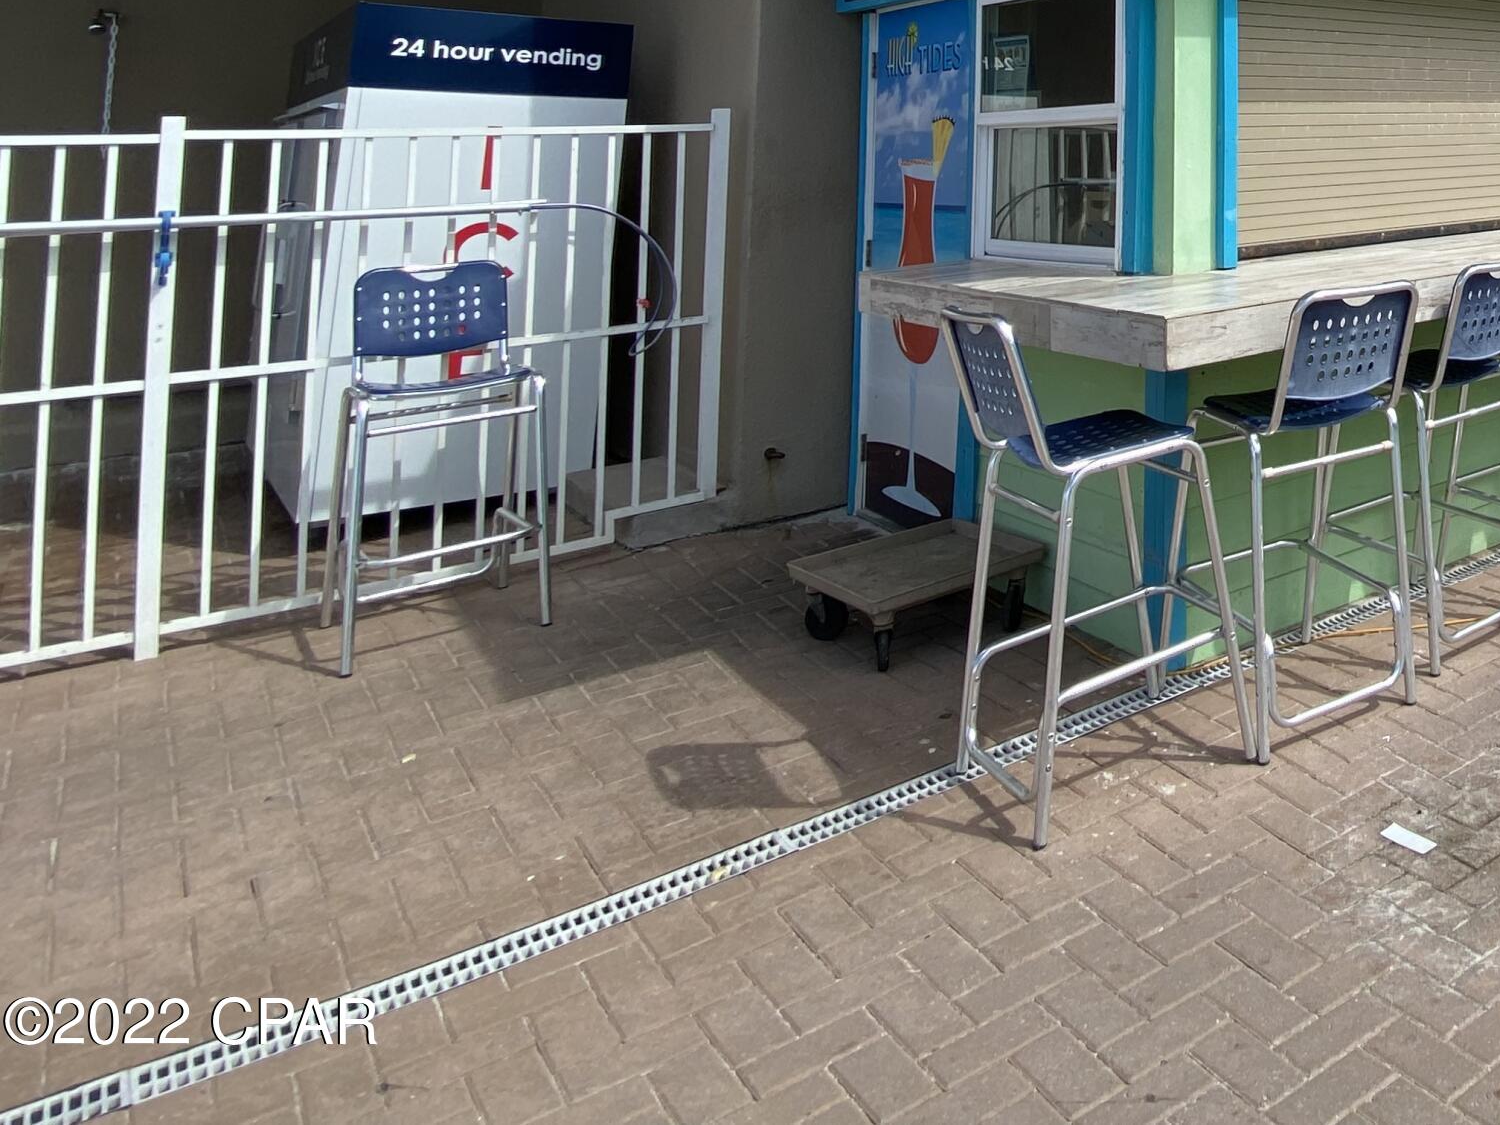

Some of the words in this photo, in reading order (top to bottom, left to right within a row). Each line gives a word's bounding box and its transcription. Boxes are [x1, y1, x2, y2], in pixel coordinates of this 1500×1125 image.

[390, 37, 425, 57] 24
[432, 39, 494, 61] hour
[500, 47, 603, 71] vending
[886, 35, 914, 76] HIGH
[918, 41, 962, 75] TIDES
